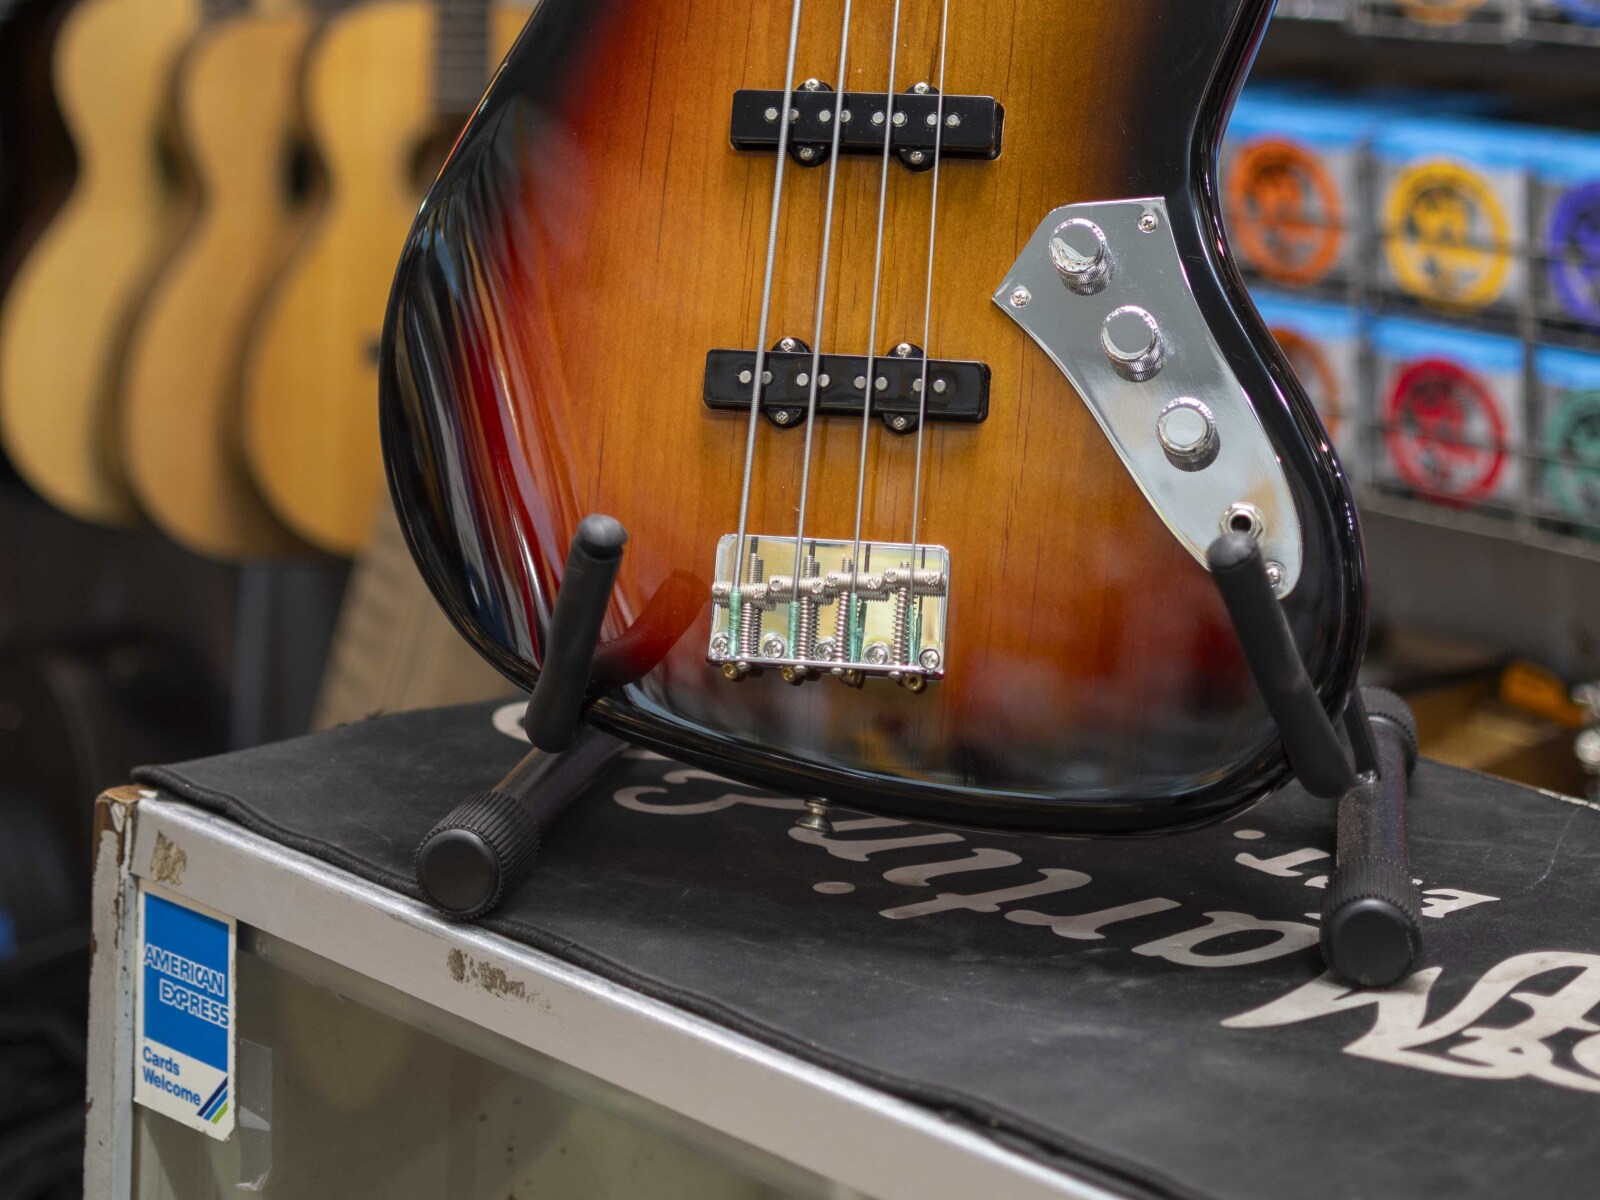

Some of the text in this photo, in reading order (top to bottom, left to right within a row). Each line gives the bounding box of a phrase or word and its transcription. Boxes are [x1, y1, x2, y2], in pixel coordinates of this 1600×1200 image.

[143, 943, 225, 997] AMERICAN
[159, 978, 229, 1029] EXPRESS
[142, 1046, 181, 1077] Cards
[142, 1065, 201, 1107] Welcome
